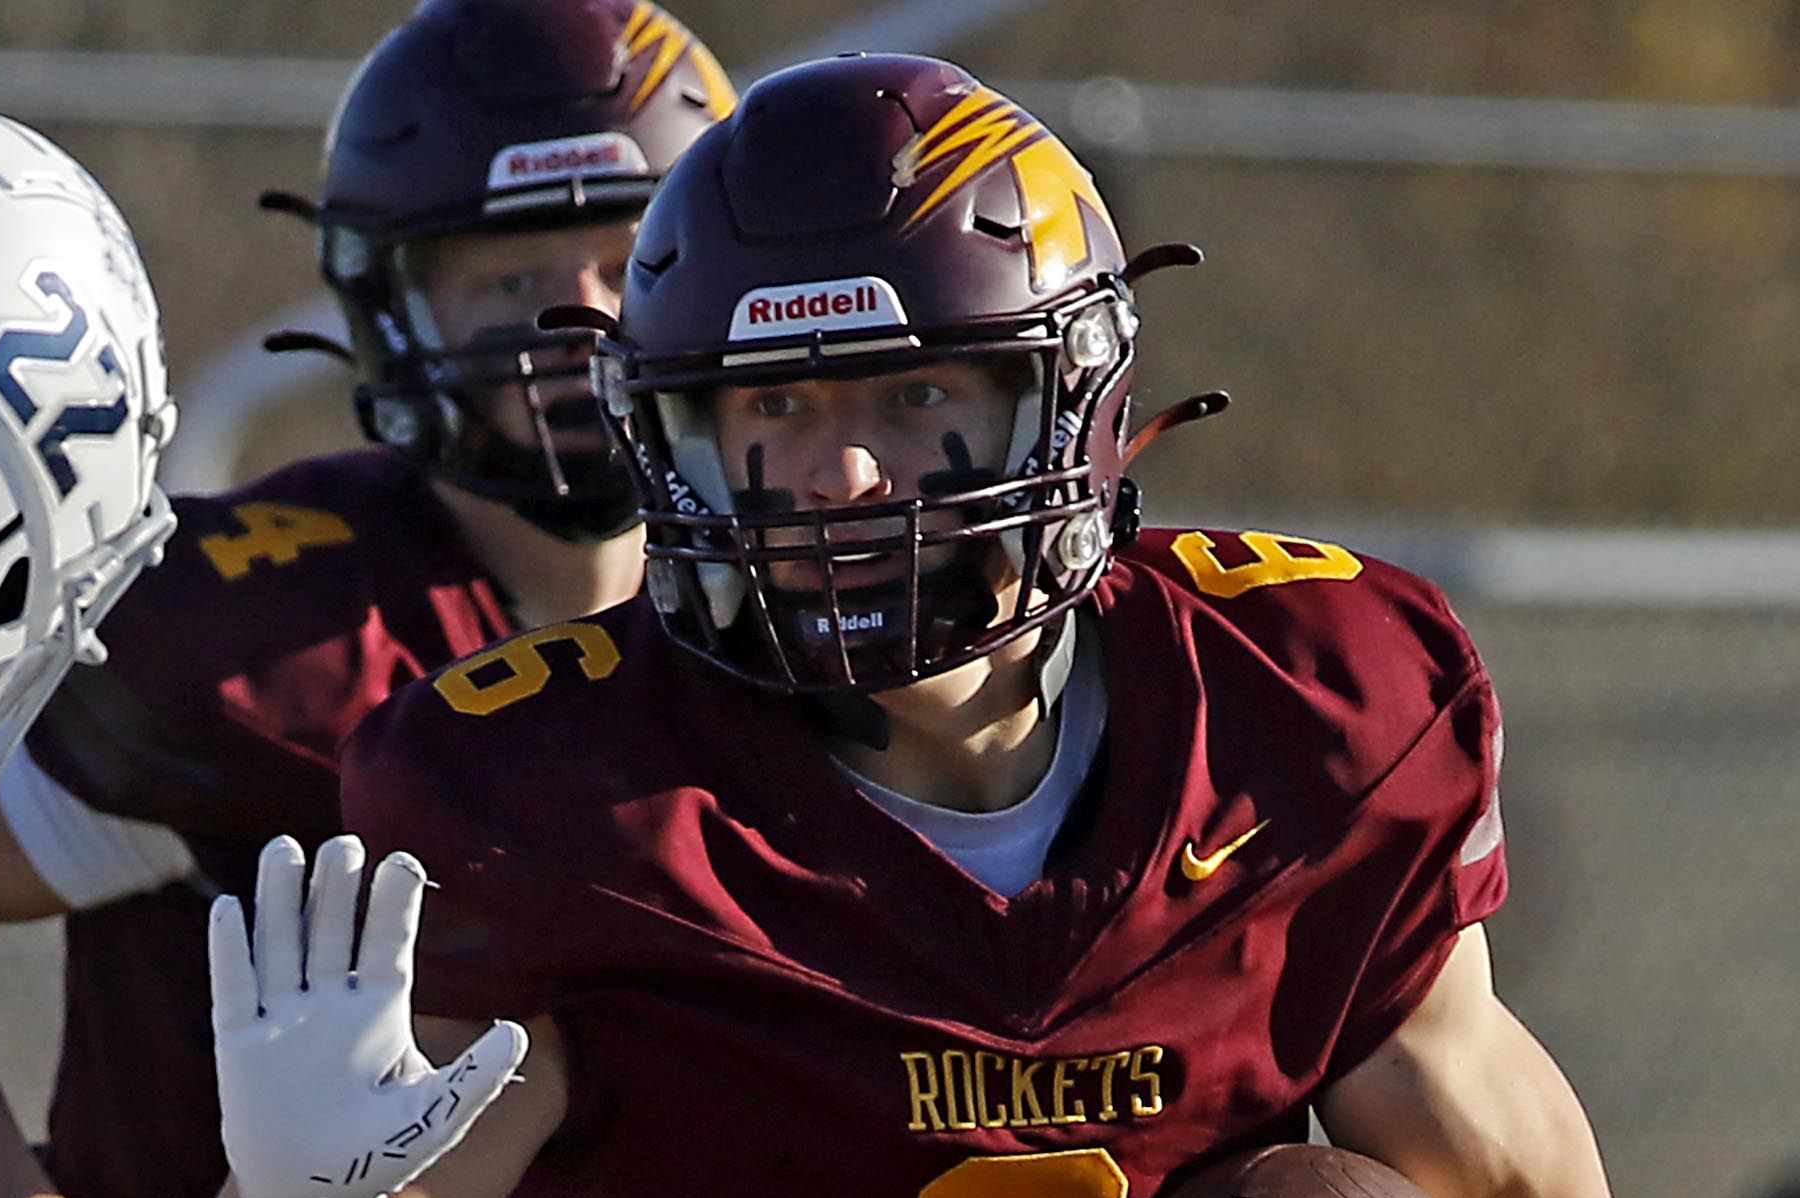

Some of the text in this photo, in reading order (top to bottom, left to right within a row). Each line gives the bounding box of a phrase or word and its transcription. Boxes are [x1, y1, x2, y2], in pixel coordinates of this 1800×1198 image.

[748, 286, 877, 325] Riddell
[199, 502, 354, 582] 4
[1170, 530, 1364, 599] 6
[816, 611, 884, 634] Rddell
[433, 622, 622, 717] 6
[899, 1044, 1164, 1132] ROCKETS
